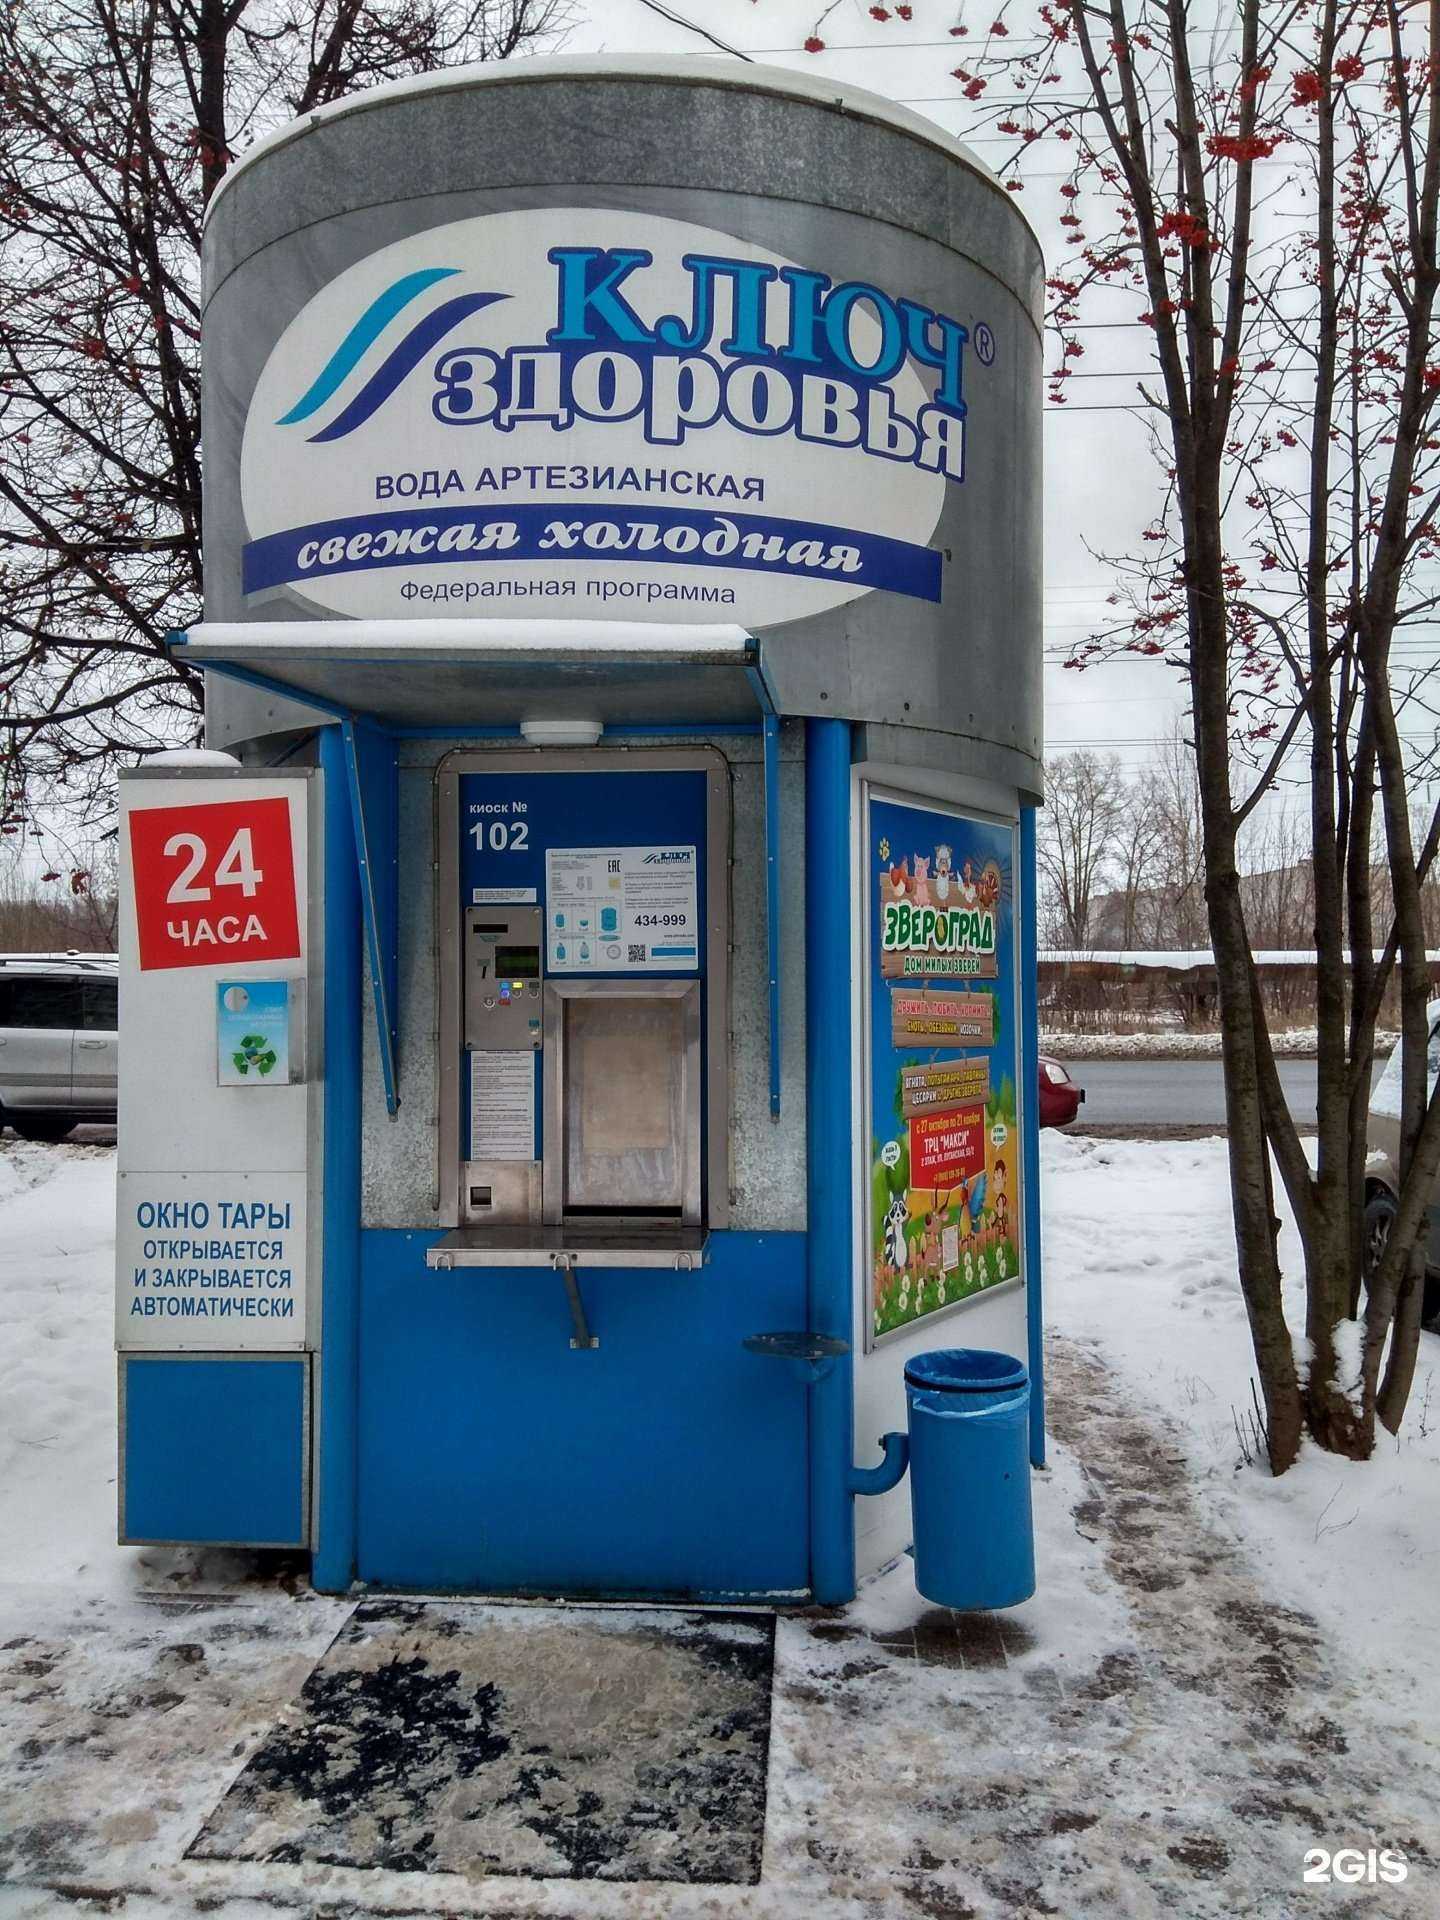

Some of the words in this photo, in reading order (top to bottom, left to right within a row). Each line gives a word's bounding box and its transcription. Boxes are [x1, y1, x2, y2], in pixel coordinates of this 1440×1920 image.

[546, 246, 969, 407] КЛЮЧ
[433, 345, 966, 484] здоровья
[374, 472, 466, 503] ВОДА
[474, 465, 766, 503] АРТЕЗИАНСКАЯ
[296, 516, 522, 570] свежая
[538, 514, 864, 574] холодная
[399, 574, 577, 604] Федеральная
[584, 578, 737, 606] программа
[469, 803, 509, 815] киоск
[512, 801, 528, 814] №
[469, 821, 529, 851] 102
[163, 827, 264, 905] 24
[166, 914, 268, 947] ЧАСА
[634, 914, 687, 926] 434-999
[884, 901, 995, 953] ЗВЕРОГРАД
[904, 956, 922, 975] ДОМ
[924, 956, 952, 974] МИЛЫХ
[953, 955, 981, 974] ЗВЕРЕЙ
[921, 1120, 928, 1133] 27
[924, 1136, 939, 1154] ТРЦ
[940, 1130, 970, 1151] "МАКСИ"
[136, 1201, 210, 1230] ОКНО
[217, 1202, 291, 1230] ТАРЫ
[143, 1239, 283, 1261] ОТКРЫВАЕТСЯ
[133, 1267, 147, 1288] И
[151, 1267, 292, 1289] ЗАКРЫВАЕТСЯ
[130, 1296, 294, 1318] АВТОМАТИЧЕСКИ
